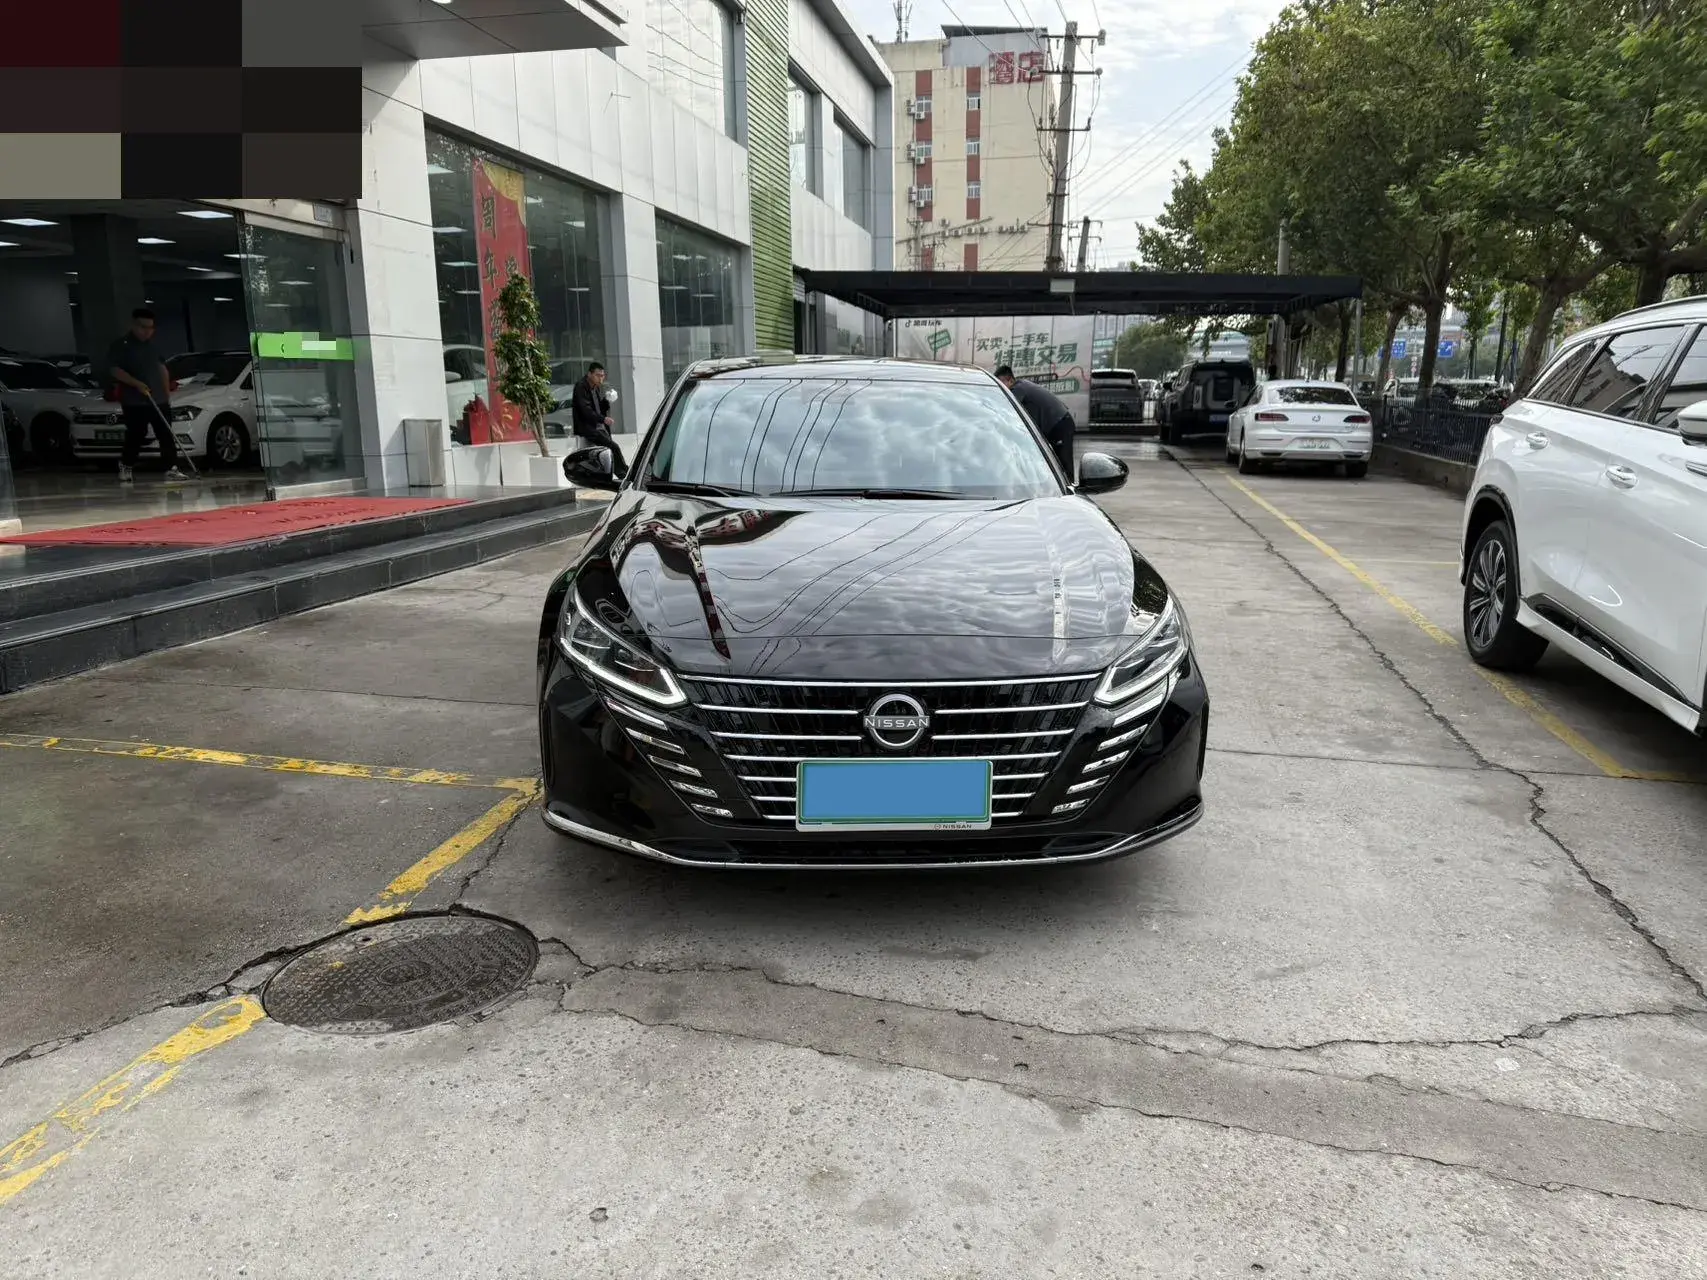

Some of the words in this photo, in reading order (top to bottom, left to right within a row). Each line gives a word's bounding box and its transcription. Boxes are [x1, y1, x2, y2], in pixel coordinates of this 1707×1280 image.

[994, 342, 1078, 368] 特惠交易
[864, 717, 929, 728] NISSAN
